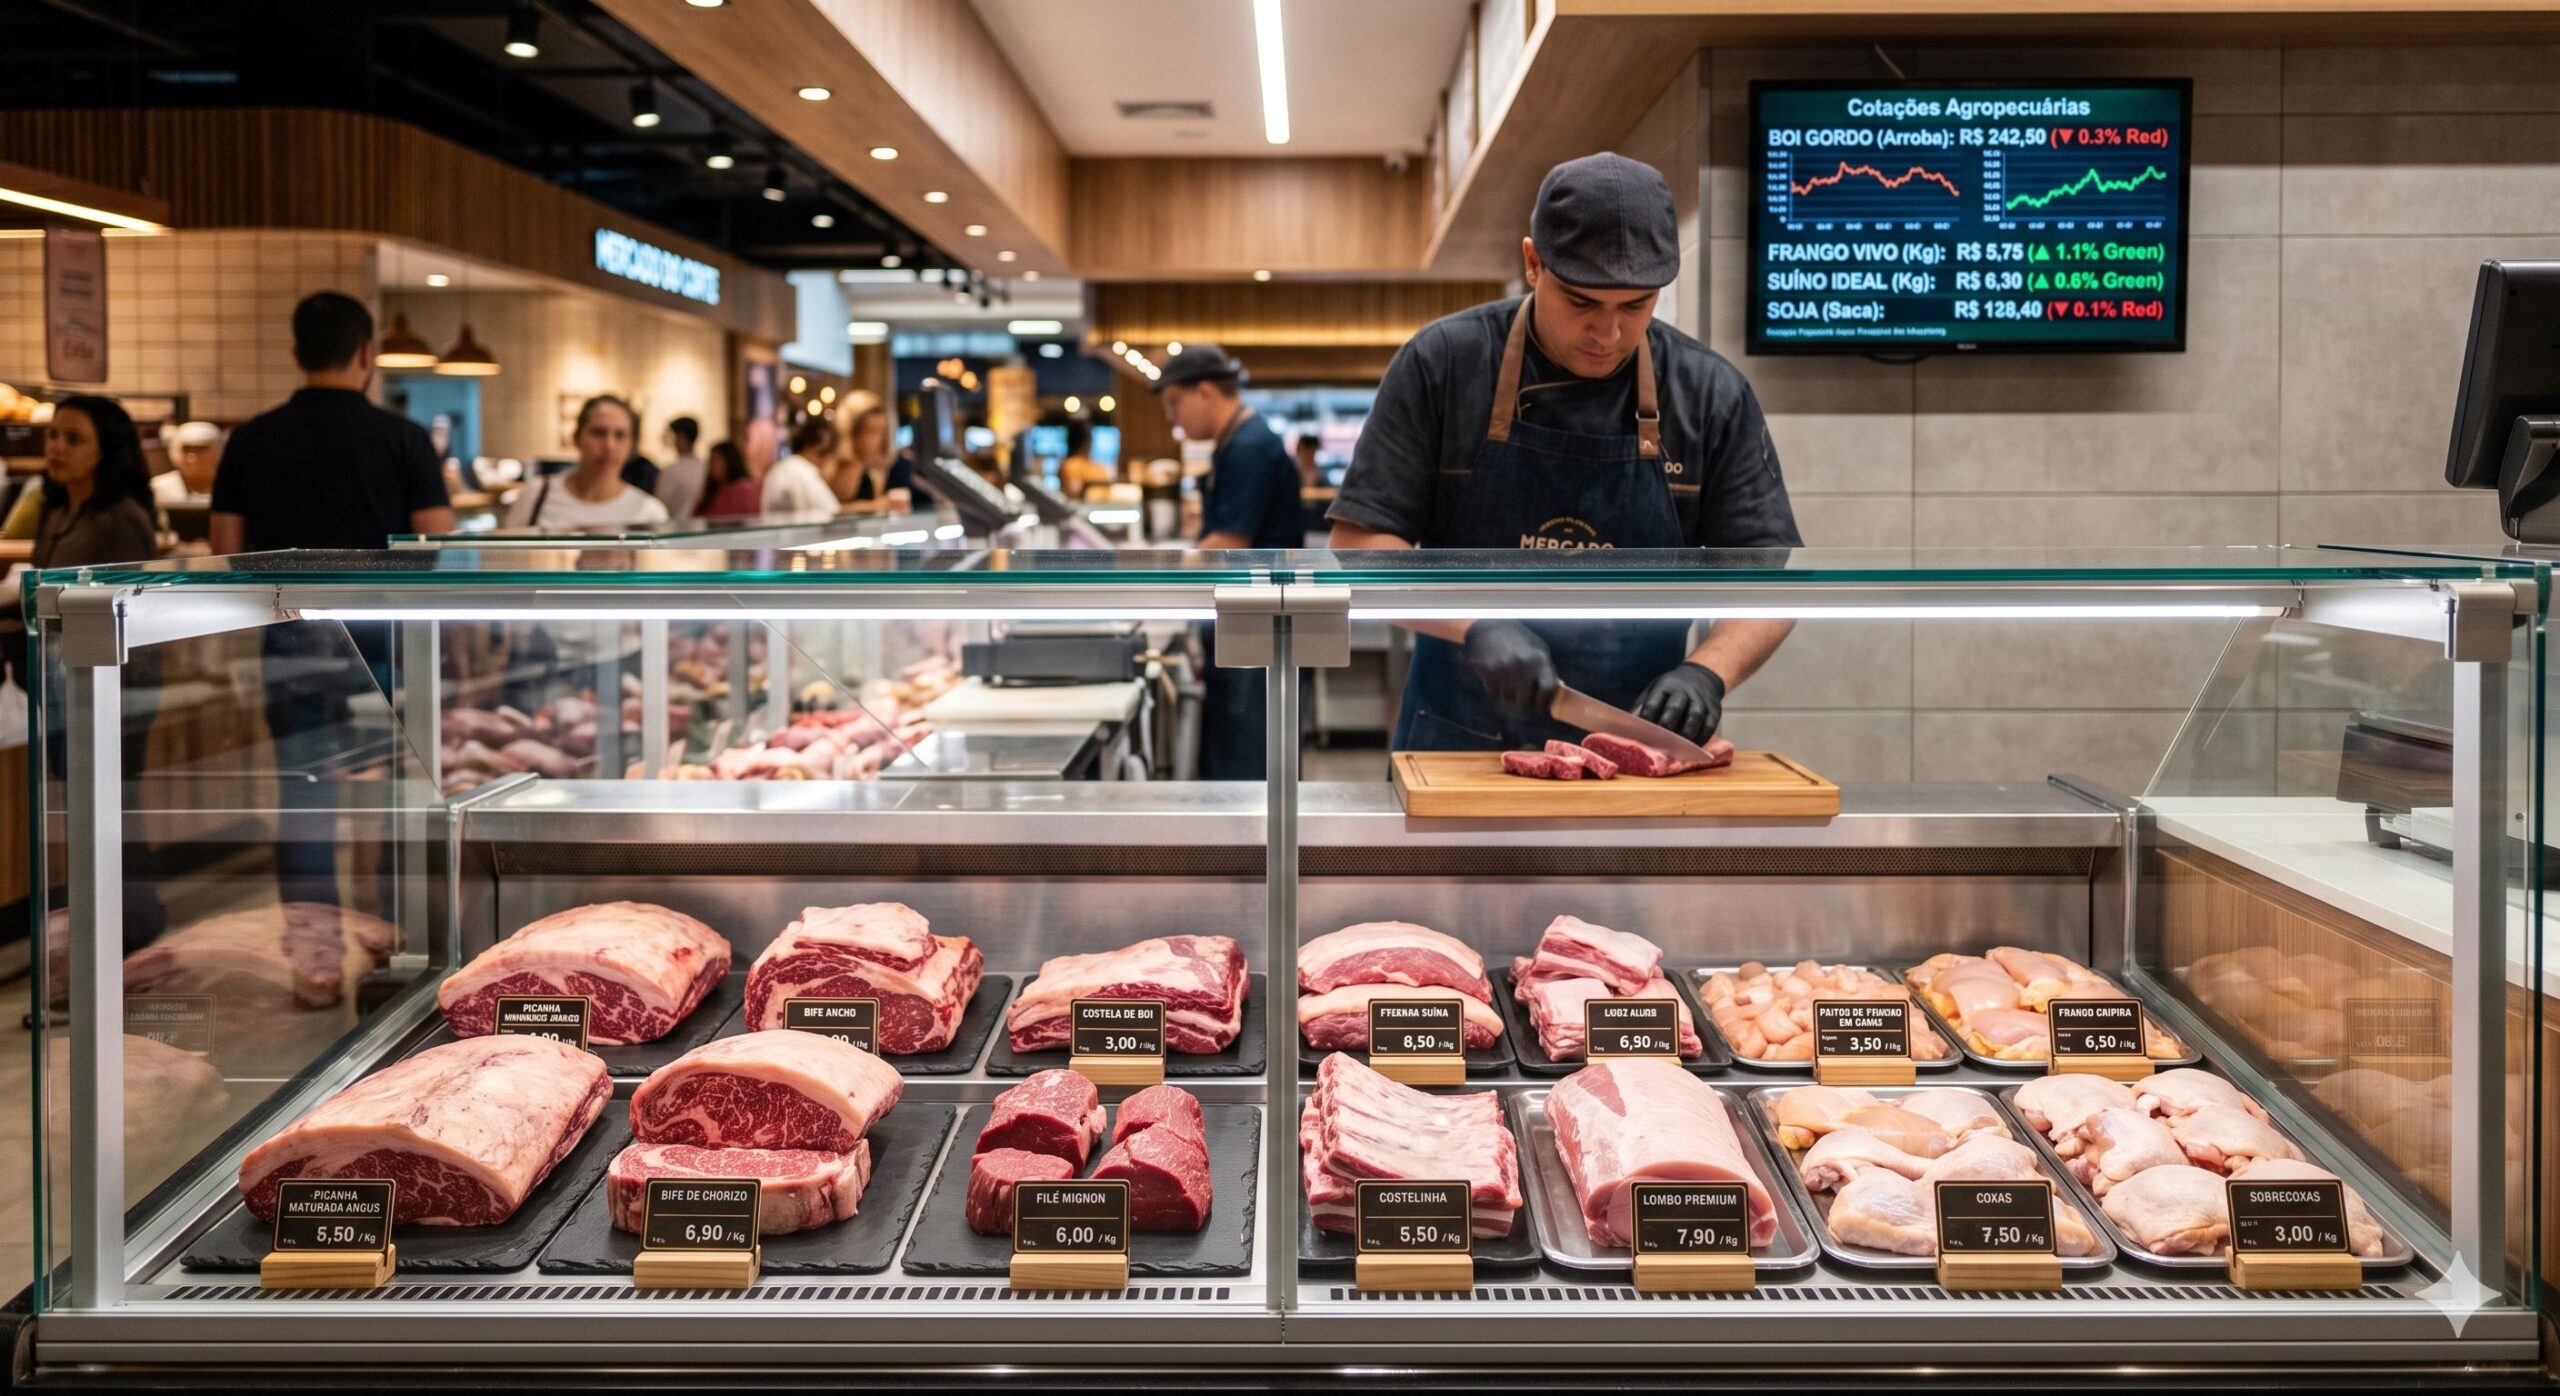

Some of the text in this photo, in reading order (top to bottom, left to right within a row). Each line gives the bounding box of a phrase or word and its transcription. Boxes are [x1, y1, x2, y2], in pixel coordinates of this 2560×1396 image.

[1848, 97, 2091, 120] Cotações Agropecuárias
[1768, 128, 1801, 146] BOI
[1805, 128, 1873, 146] GORDO
[1877, 128, 1954, 149] (Arroba):
[1959, 127, 1984, 147] R$
[1988, 128, 2047, 148] 242,50
[2126, 128, 2169, 148] Red)
[1768, 243, 1850, 261] FRANGO
[1852, 243, 1899, 261] VIVO
[1902, 243, 1946, 264] (Kg):
[1956, 242, 1981, 262] R$
[1986, 243, 2024, 262] 5,75
[2056, 243, 2099, 260] 1.1%
[2103, 243, 2165, 264] Green)
[1767, 268, 1828, 291] SUÍNO
[1831, 272, 1888, 290] IDEAL
[1892, 271, 1936, 294] (Kg):
[1956, 271, 1981, 291] R$
[1984, 272, 2023, 291] 6,30
[2103, 272, 2164, 292] Green)
[1767, 301, 1819, 319] SOJA
[1822, 301, 1885, 323] (Saca):
[1955, 300, 1979, 320] R$
[1984, 300, 2043, 320] 128,40
[2122, 301, 2164, 321] Red)
[523, 1004, 561, 1013] PICANHA
[804, 1008, 857, 1017] BIFE ANCHO
[1083, 1009, 1154, 1019] COSTELA DE BOI
[1853, 1008, 1864, 1017] DE
[2096, 1008, 2132, 1017] CAIPIRA
[1839, 1018, 1852, 1027] EM
[1105, 1036, 1136, 1052] 3,00
[1403, 1035, 1435, 1051] 8,50
[1620, 1035, 1651, 1051] 6,90
[1850, 1037, 1882, 1053] 3,50
[2085, 1035, 2116, 1051] 6,50
[661, 1190, 748, 1201] BIFE DE CHORIZO
[1036, 1190, 1106, 1204] FILÉ MIGNON
[1379, 1192, 1447, 1203] COSTELINHA
[1643, 1194, 1737, 1205] LOMBO PREMIUM
[1976, 1192, 2012, 1204] COXAS
[2250, 1191, 2321, 1202] SOBRECOXAS
[289, 1202, 381, 1213] MATURADA ANGUS
[317, 1226, 354, 1244] 5,50
[685, 1224, 723, 1243] 6,90
[1056, 1227, 1093, 1245] 6,00
[1400, 1226, 1437, 1245] 5,50
[1677, 1228, 1715, 1247] 7,90
[1982, 1227, 2020, 1246] 7,50
[2275, 1225, 2313, 1245] 3,00
